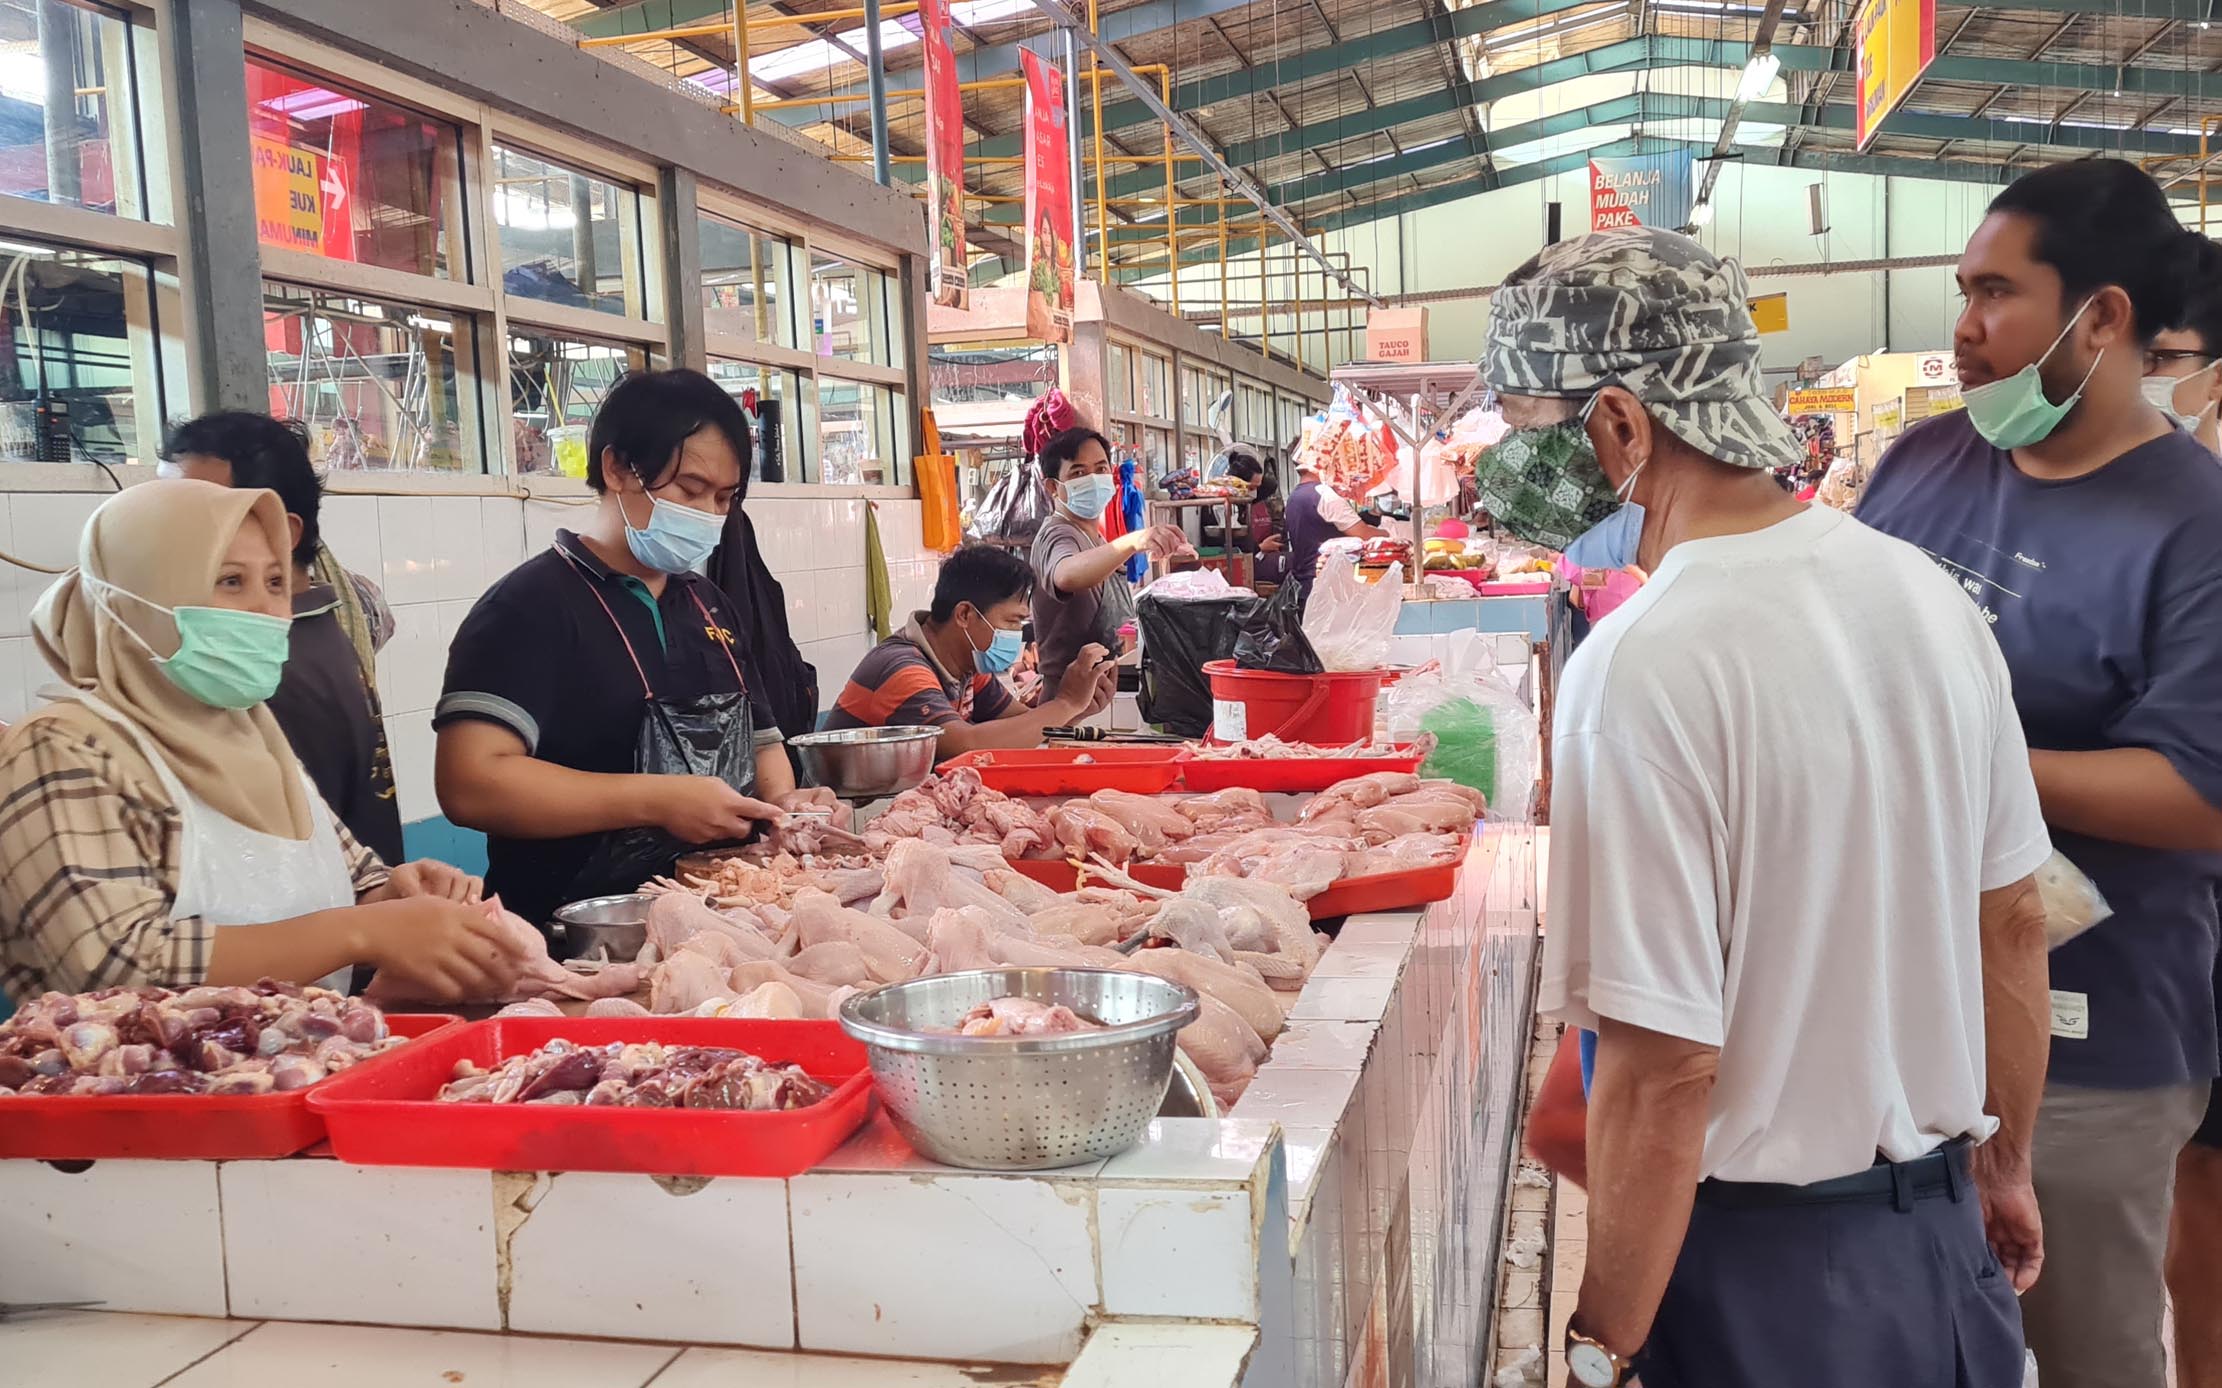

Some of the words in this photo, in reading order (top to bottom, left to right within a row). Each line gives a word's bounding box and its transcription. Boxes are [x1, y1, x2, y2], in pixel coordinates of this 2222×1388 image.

[1595, 169, 1660, 190] BELANJA
[1595, 190, 1650, 209] MUDAH
[1596, 211, 1634, 228] PAKE
[1379, 340, 1409, 349] TAUCO
[1379, 349, 1409, 358] GAJAH
[704, 626, 735, 644] FC
